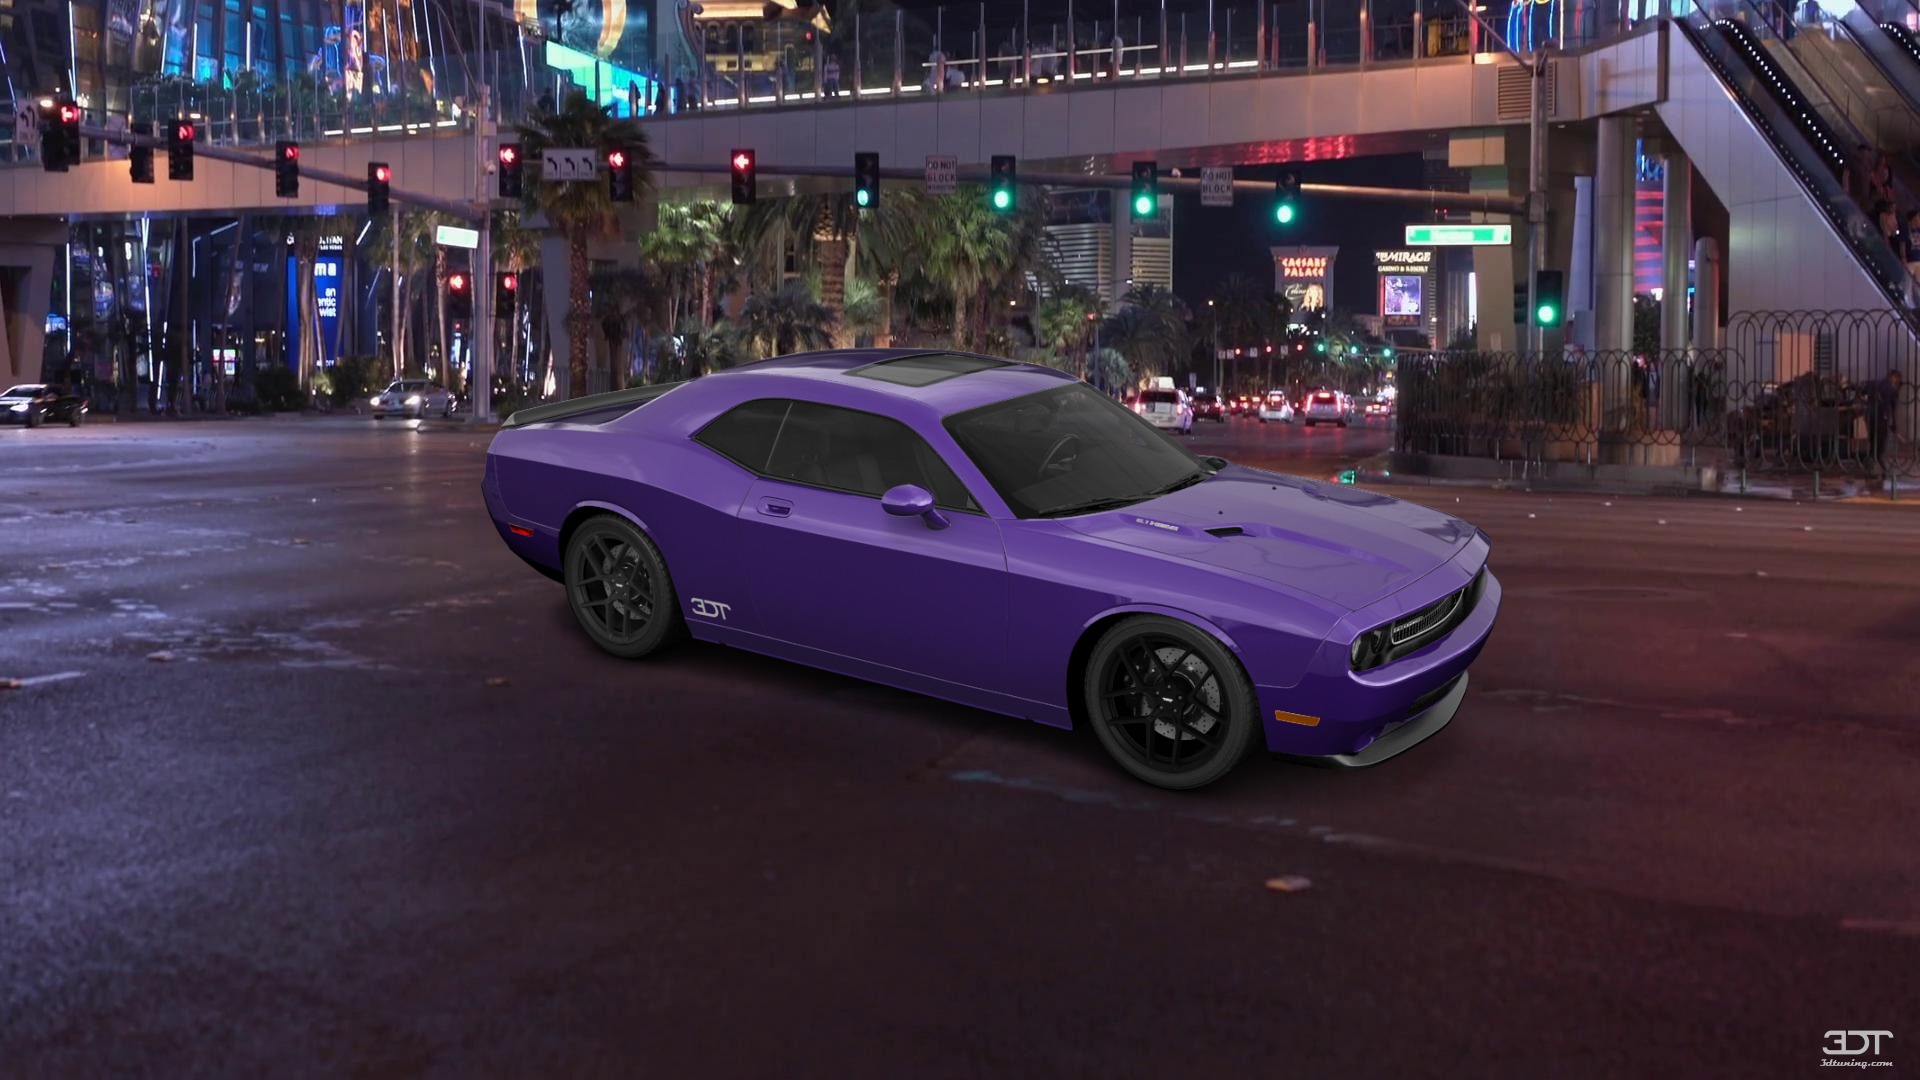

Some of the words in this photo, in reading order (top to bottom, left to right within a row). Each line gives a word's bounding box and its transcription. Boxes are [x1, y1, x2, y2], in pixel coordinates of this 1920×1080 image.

[928, 174, 955, 182] BLOCK
[1282, 257, 1327, 267] CAESARS
[1387, 252, 1431, 263] MIRAGE
[1284, 267, 1324, 277] PALACE
[691, 597, 731, 620] 3DT
